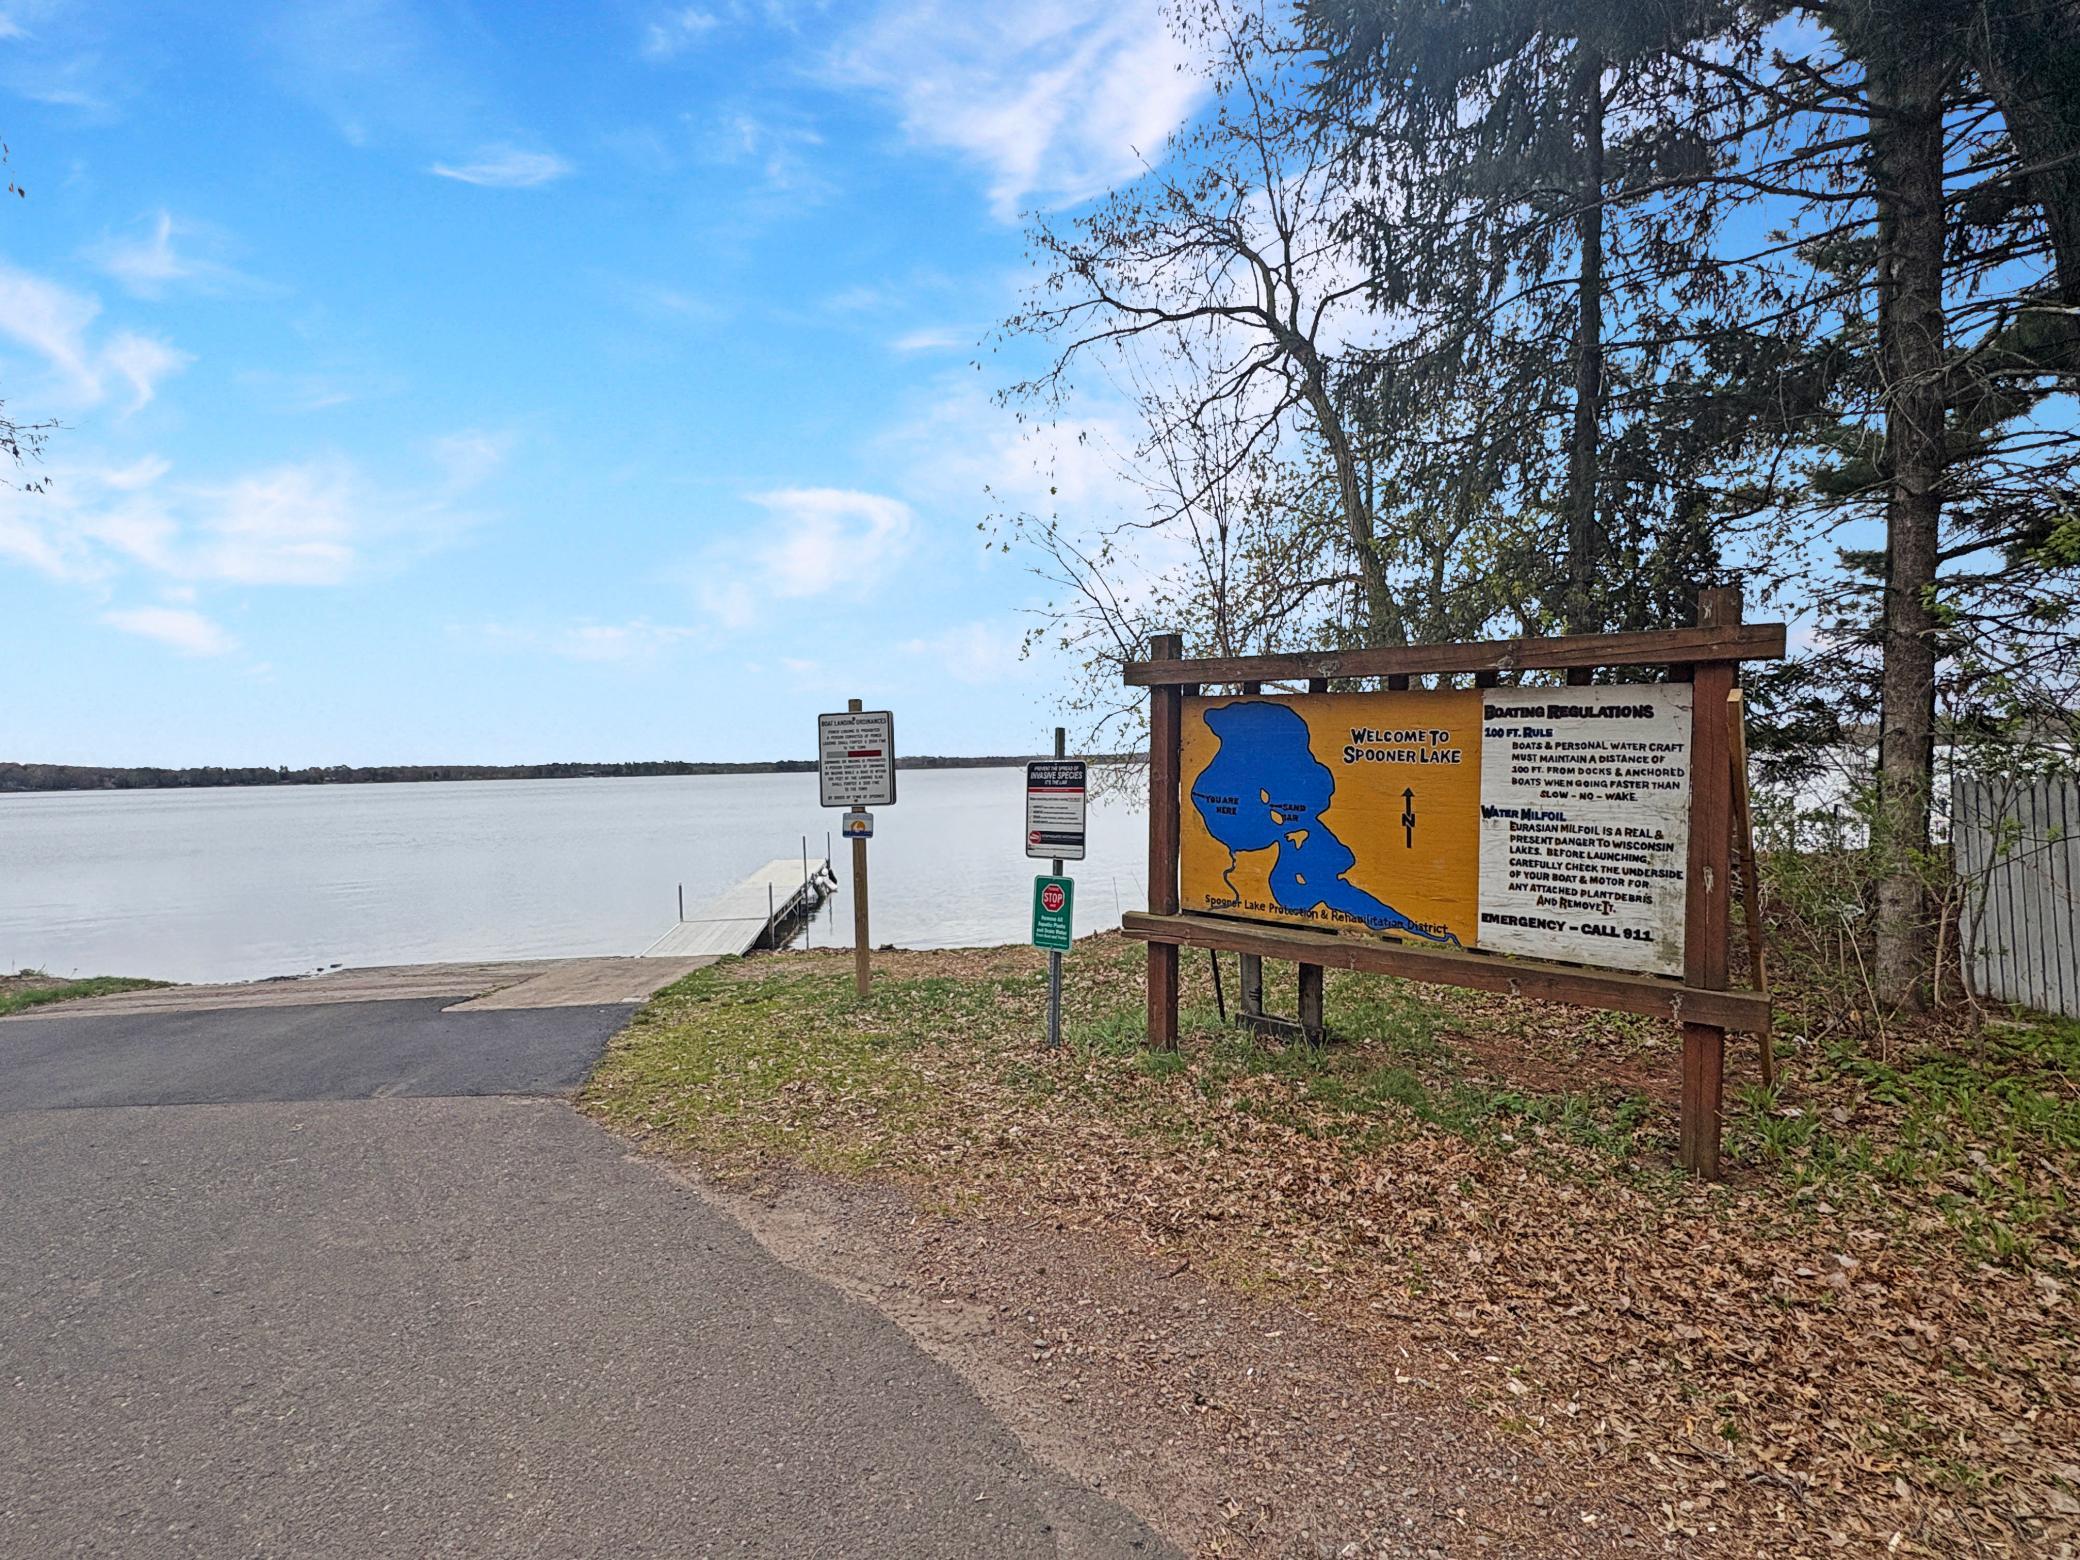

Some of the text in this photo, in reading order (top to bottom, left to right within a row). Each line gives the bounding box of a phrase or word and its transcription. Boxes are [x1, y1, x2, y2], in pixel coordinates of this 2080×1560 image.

[1484, 705, 1655, 720] BOATING REGULATIONS
[1350, 728, 1450, 746] WELCOME TO
[1484, 727, 1504, 738] 100
[1523, 727, 1553, 738] RULE
[1512, 741, 1685, 752] BOATS & PERSONAL WATER CRAFT
[1343, 746, 1461, 763] SPOONER LAKE
[1511, 753, 1666, 764] MUST MAINTAIN A DISTANCE OF
[1030, 771, 1083, 780] INVASIVE SPECIES
[1511, 766, 1529, 774] 100
[1547, 766, 1575, 774] FROM
[1577, 767, 1612, 775] DOCKS
[1615, 767, 1623, 777] &
[1625, 767, 1685, 777] ANCHORED
[1511, 777, 1681, 790] BOATS WHEN GOING FASTER THAN
[1540, 790, 1569, 799] SLOW
[1579, 792, 1594, 800] NO
[1216, 806, 1237, 815] HERE
[1481, 805, 1567, 822] WATER MILFOIL
[1509, 821, 1664, 840] EURASIAN MILFOIL IS A REAL &
[1509, 834, 1675, 852] PRESENT DANGER TO WISCONSIN
[1546, 848, 1585, 859] BEFORE
[1509, 858, 1684, 880] CAREFULLY CHECK THE UNDERSIDE
[1509, 870, 1650, 889] OF YOUR BOAT & MOTOR FOR
[1508, 882, 1529, 891] ANY
[1529, 884, 1578, 896] ATTACHED
[1044, 892, 1063, 904] STOP
[1537, 895, 1557, 907] AND
[1205, 894, 1448, 934] Spooner Lake Protection & Rehabilitation District
[1481, 912, 1566, 931] EMERGENCY
[1581, 923, 1620, 938] CALL
